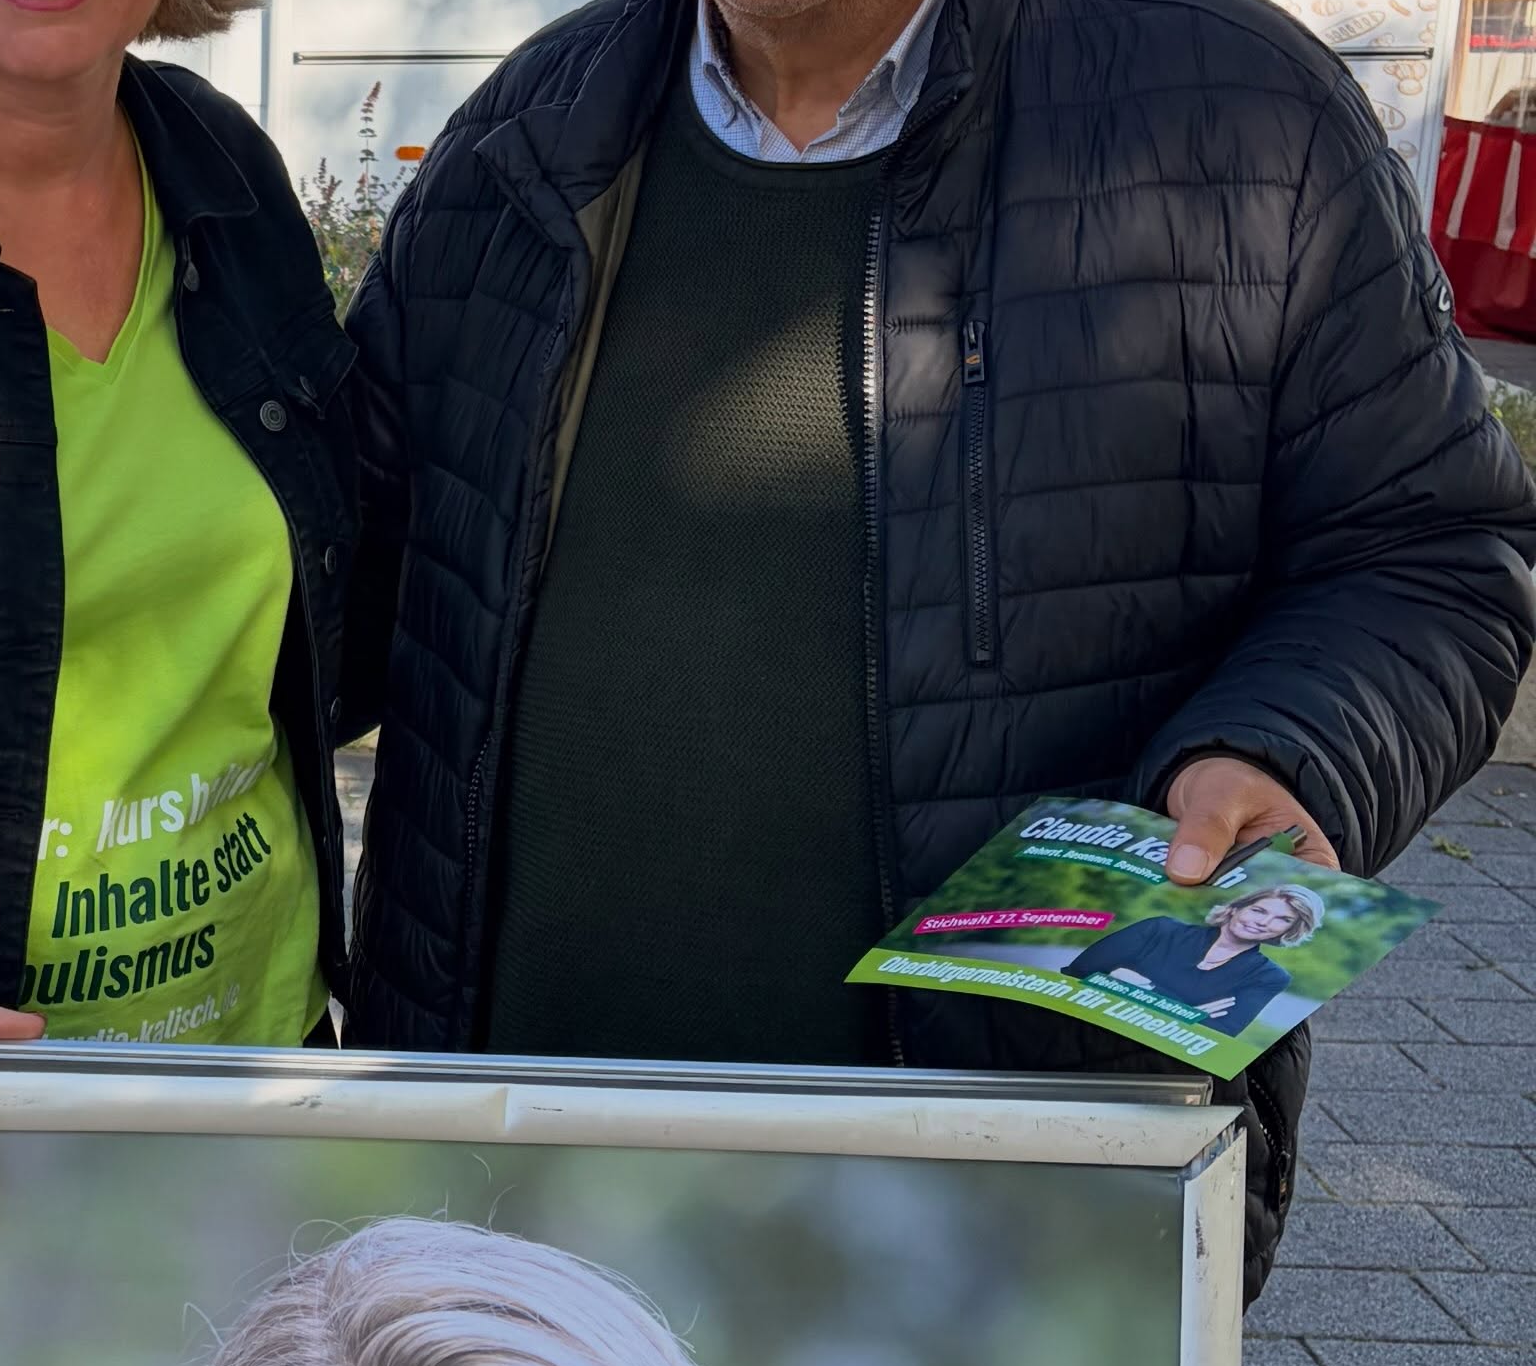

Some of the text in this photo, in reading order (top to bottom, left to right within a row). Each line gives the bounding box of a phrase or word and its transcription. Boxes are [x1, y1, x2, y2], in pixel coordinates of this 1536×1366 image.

[1020, 816, 1134, 850] Claudia
[52, 812, 272, 939] Inhalte statt
[924, 913, 991, 929] Stichwahl
[1019, 912, 1105, 927] September
[878, 955, 1219, 1056] Oberbürgermeisterin für Lüneburg
